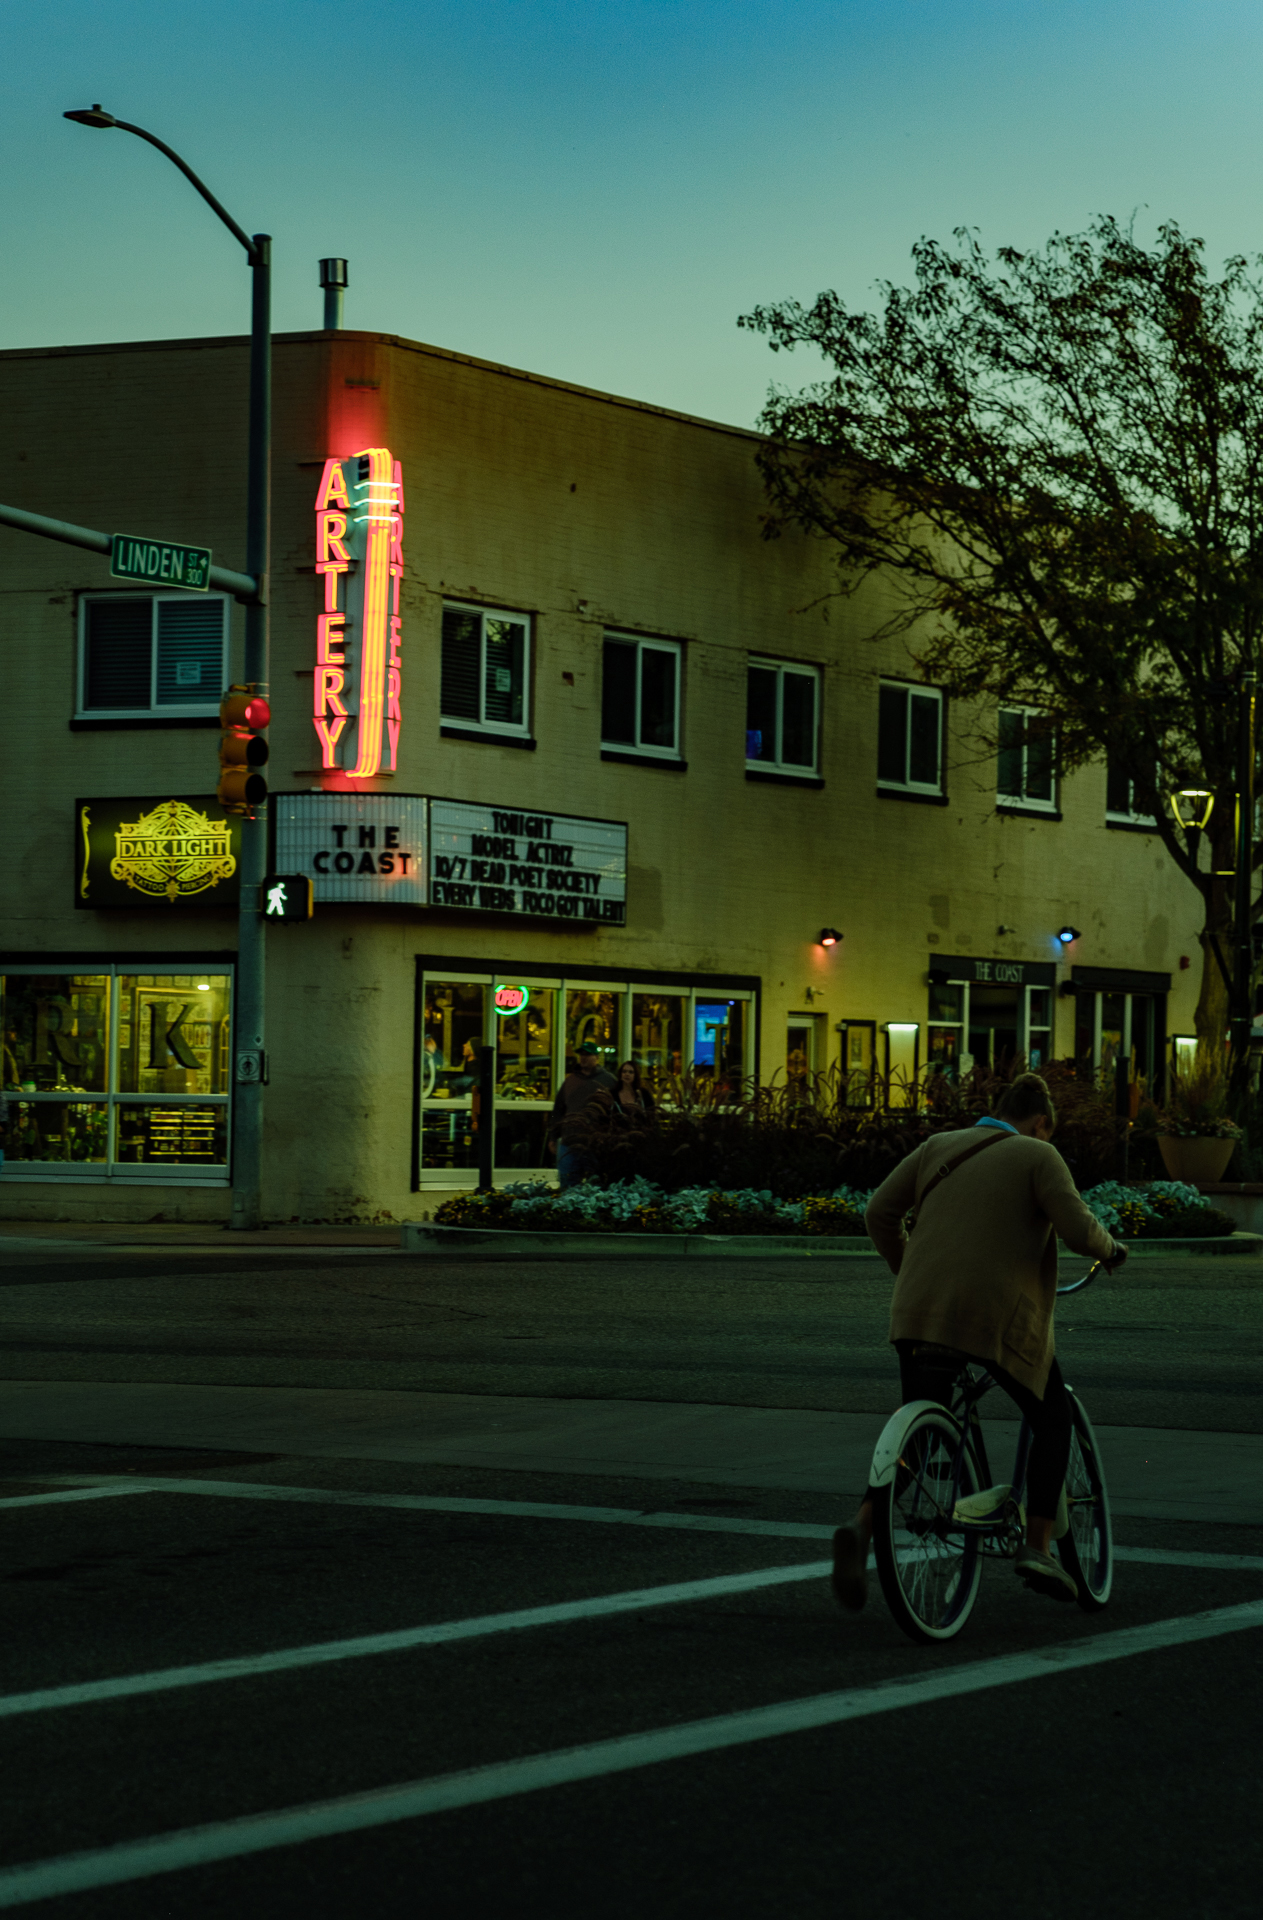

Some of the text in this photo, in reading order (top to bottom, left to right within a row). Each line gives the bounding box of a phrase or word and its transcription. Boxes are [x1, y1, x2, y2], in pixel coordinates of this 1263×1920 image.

[118, 541, 199, 580] LINDEN ST
[186, 568, 204, 586] 300
[313, 457, 350, 769] ARTERY
[332, 825, 399, 848] THE
[492, 810, 553, 840] TONIGHT
[121, 839, 226, 857] DARK LIGHT
[472, 833, 574, 867] MODEL ACTRIZ
[313, 851, 411, 875] COAST
[435, 855, 602, 895] 10/7 DEAD POET SOCIETY
[134, 875, 165, 891] TATTOO
[432, 881, 626, 922] EVERY WEDS FOCO GOT TALENT
[974, 961, 1025, 983] THE COAST
[495, 989, 524, 1007] OPEN
